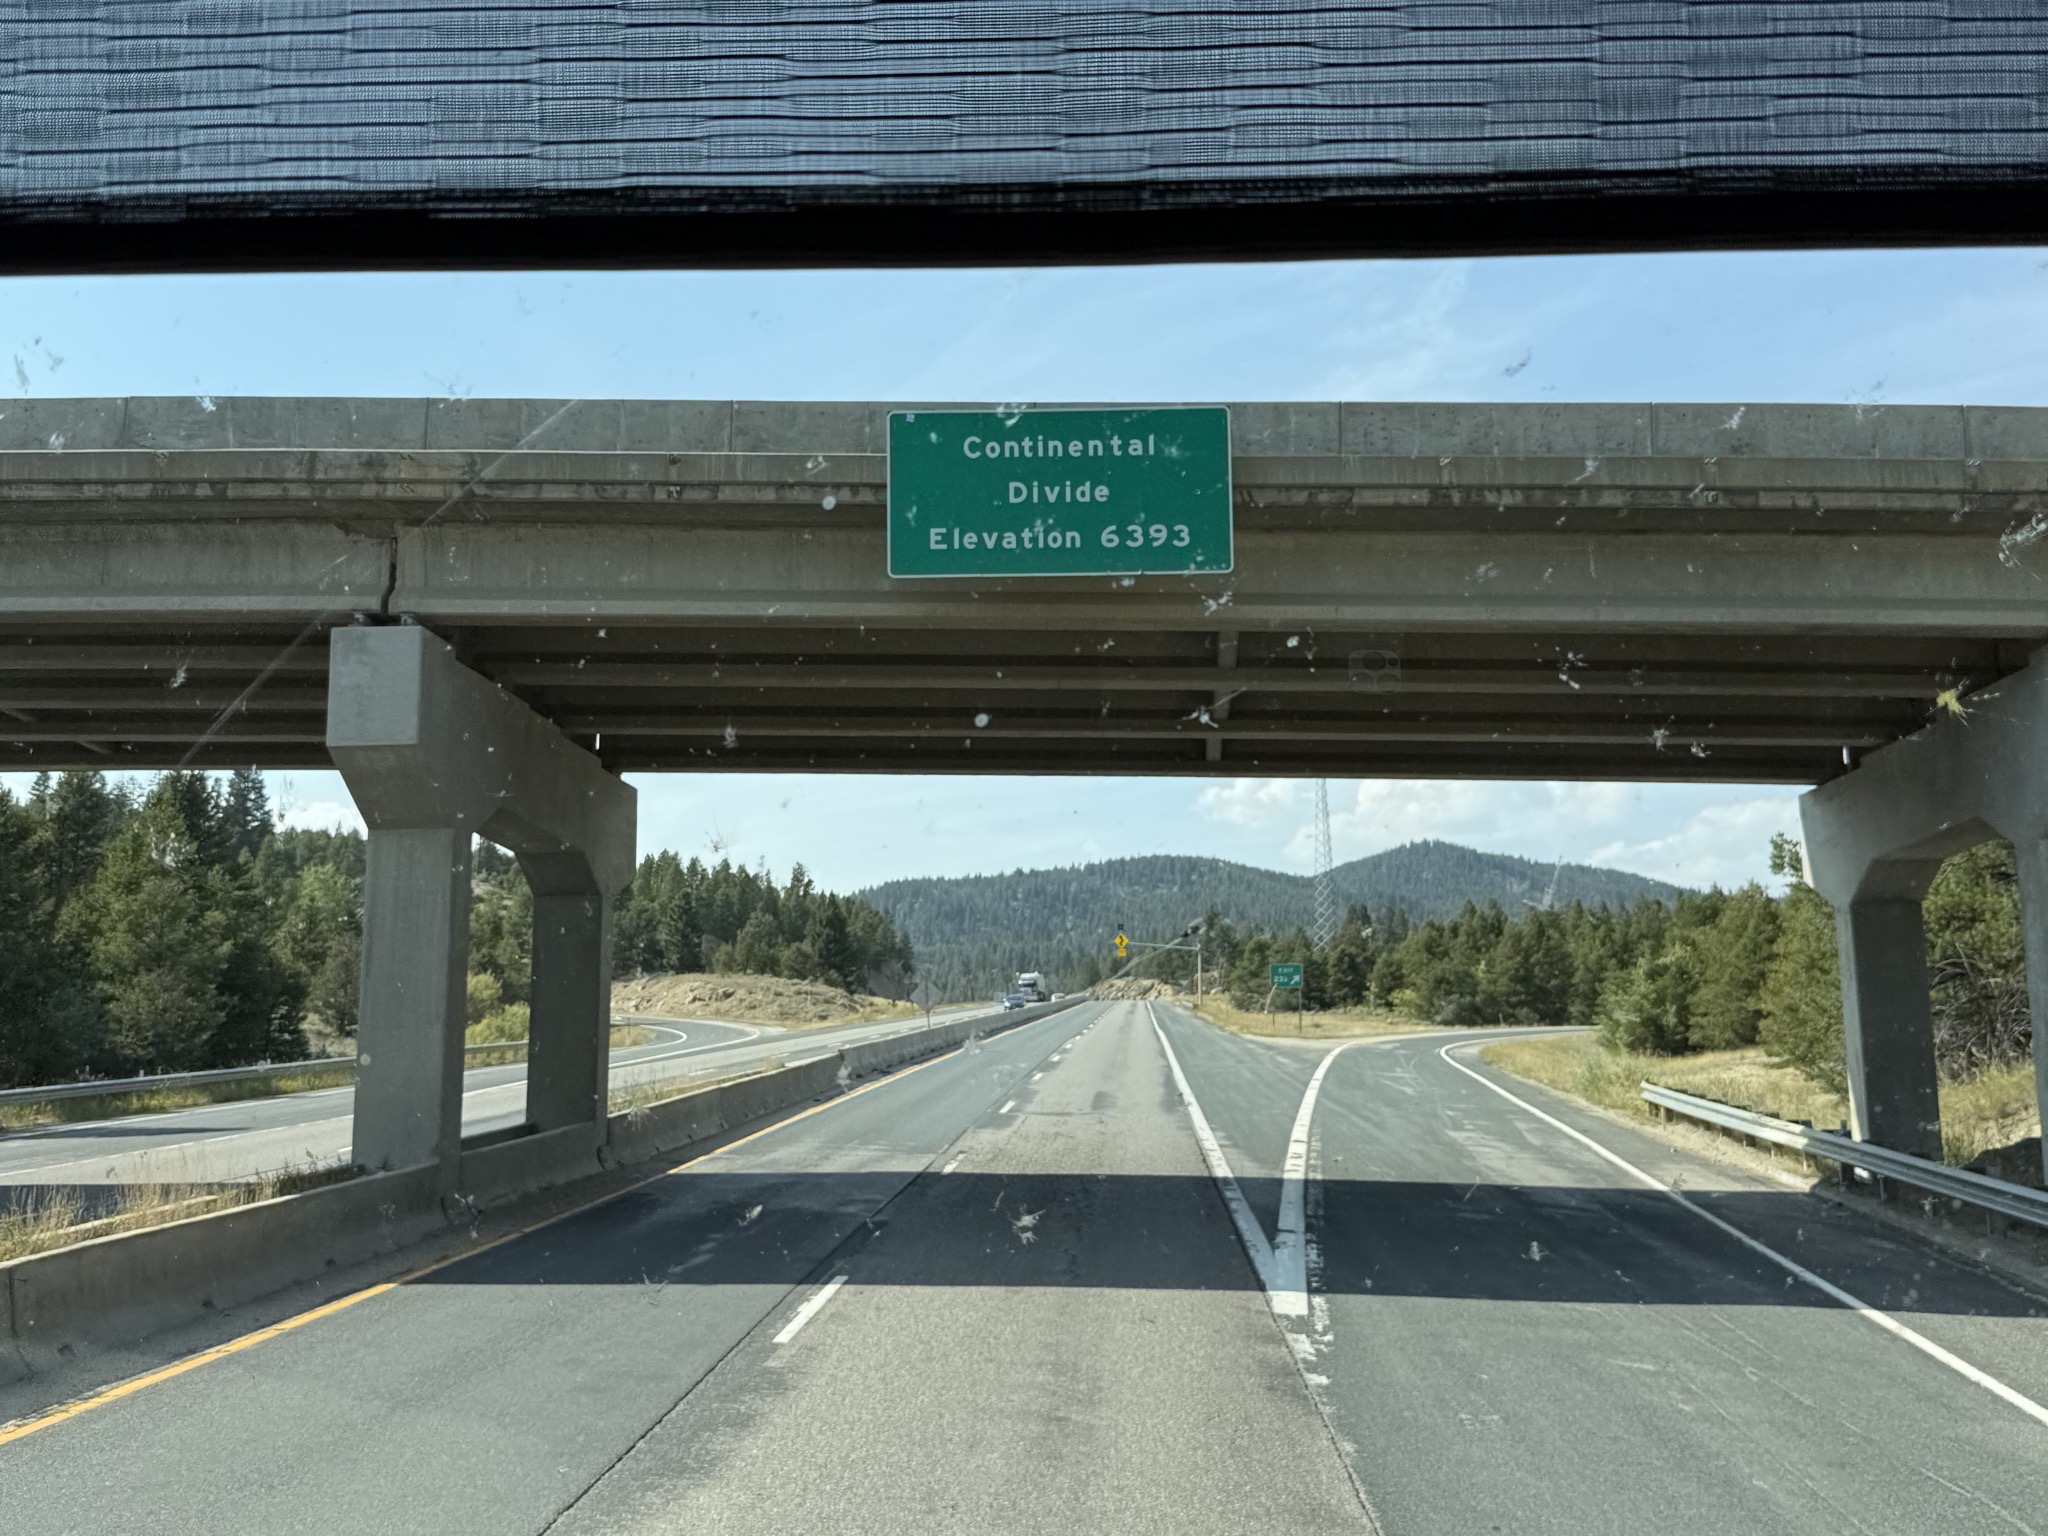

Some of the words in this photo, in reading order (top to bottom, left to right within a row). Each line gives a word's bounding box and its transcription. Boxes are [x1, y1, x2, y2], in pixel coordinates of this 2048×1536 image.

[963, 434, 1155, 459] Continental
[1008, 480, 1110, 504] Divide
[929, 527, 1081, 550] Elevation
[1100, 524, 1191, 548] 6393
